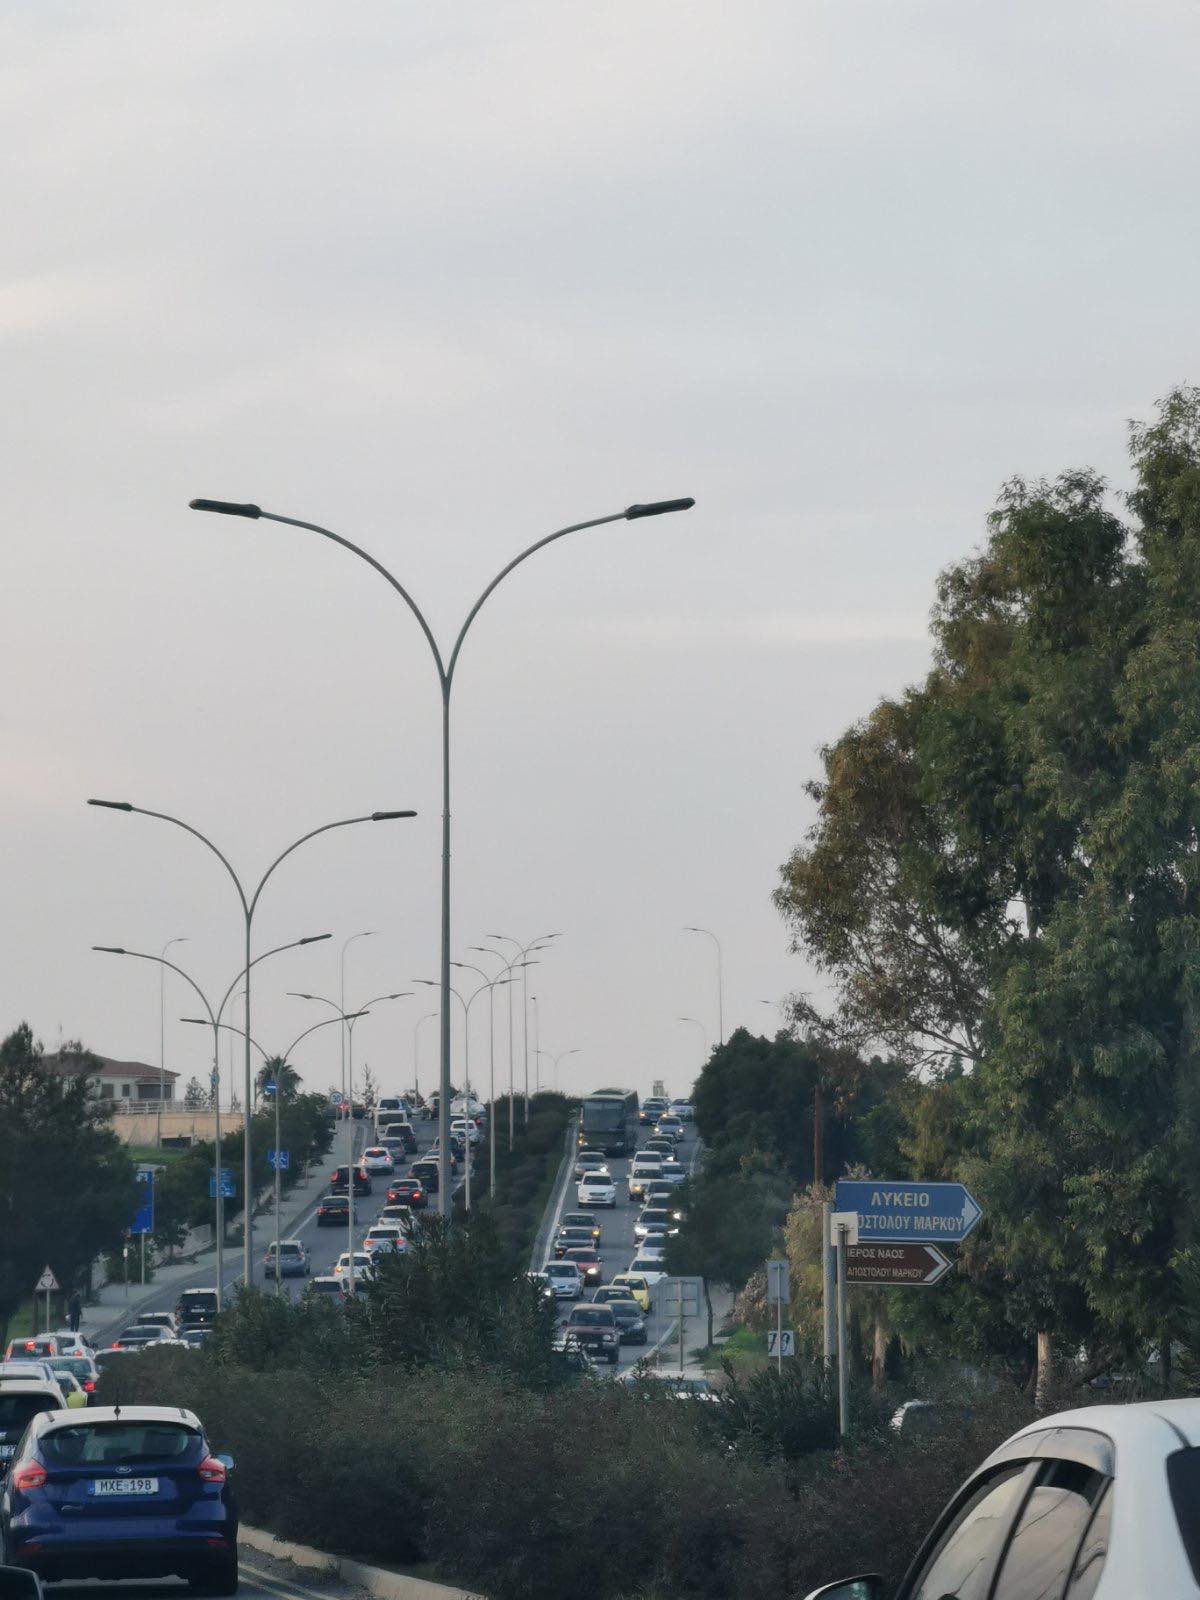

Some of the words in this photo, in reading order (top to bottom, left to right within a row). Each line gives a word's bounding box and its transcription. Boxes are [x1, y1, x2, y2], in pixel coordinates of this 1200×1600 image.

[871, 1191, 930, 1207] ΛΥΚΕΙΟ
[858, 1214, 911, 1230] ΟΣΤΟΛΟΥ
[914, 1216, 964, 1231] ΜΑΡΚΟΥ
[847, 1248, 875, 1258] ΙΕΡΟΣ
[877, 1249, 905, 1259] ΝΑΟΣ
[847, 1267, 891, 1277] ΑΠΟΣΤΟΛΟΥ
[892, 1268, 923, 1278] ΜΑΡΚΟΥ
[100, 1480, 123, 1491] MXE
[130, 1479, 152, 1491] 198
